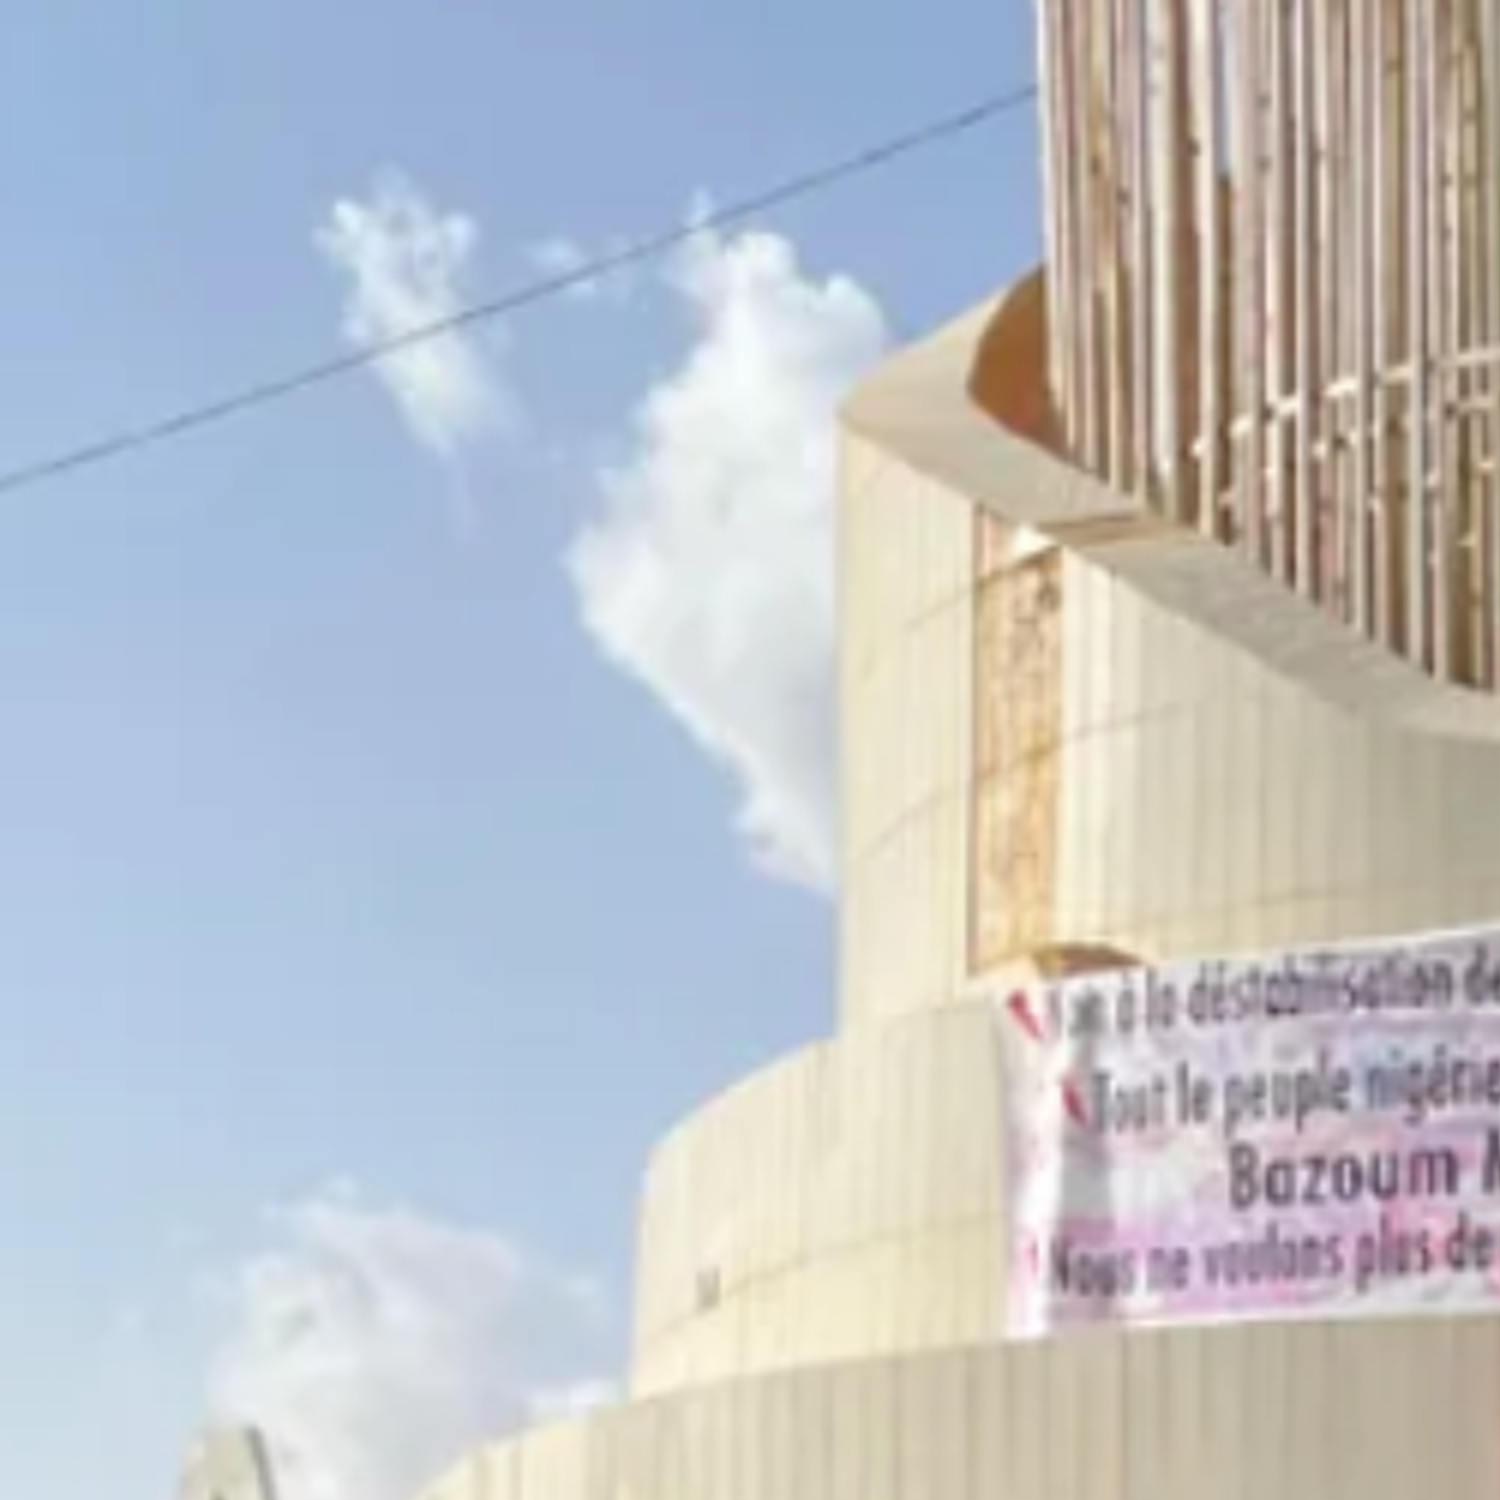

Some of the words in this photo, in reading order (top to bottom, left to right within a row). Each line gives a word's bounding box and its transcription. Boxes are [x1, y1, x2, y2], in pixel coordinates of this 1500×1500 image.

[1091, 1072, 1166, 1135] Tout
[1176, 1060, 1214, 1124] le
[1224, 1044, 1350, 1136] peuple
[1228, 1144, 1460, 1212] Bazoum
[1050, 1236, 1135, 1297] Nous
[1147, 1243, 1190, 1291] ne
[1204, 1222, 1344, 1287] voulons
[1355, 1210, 1431, 1294] plus
[1446, 1210, 1494, 1273] de
